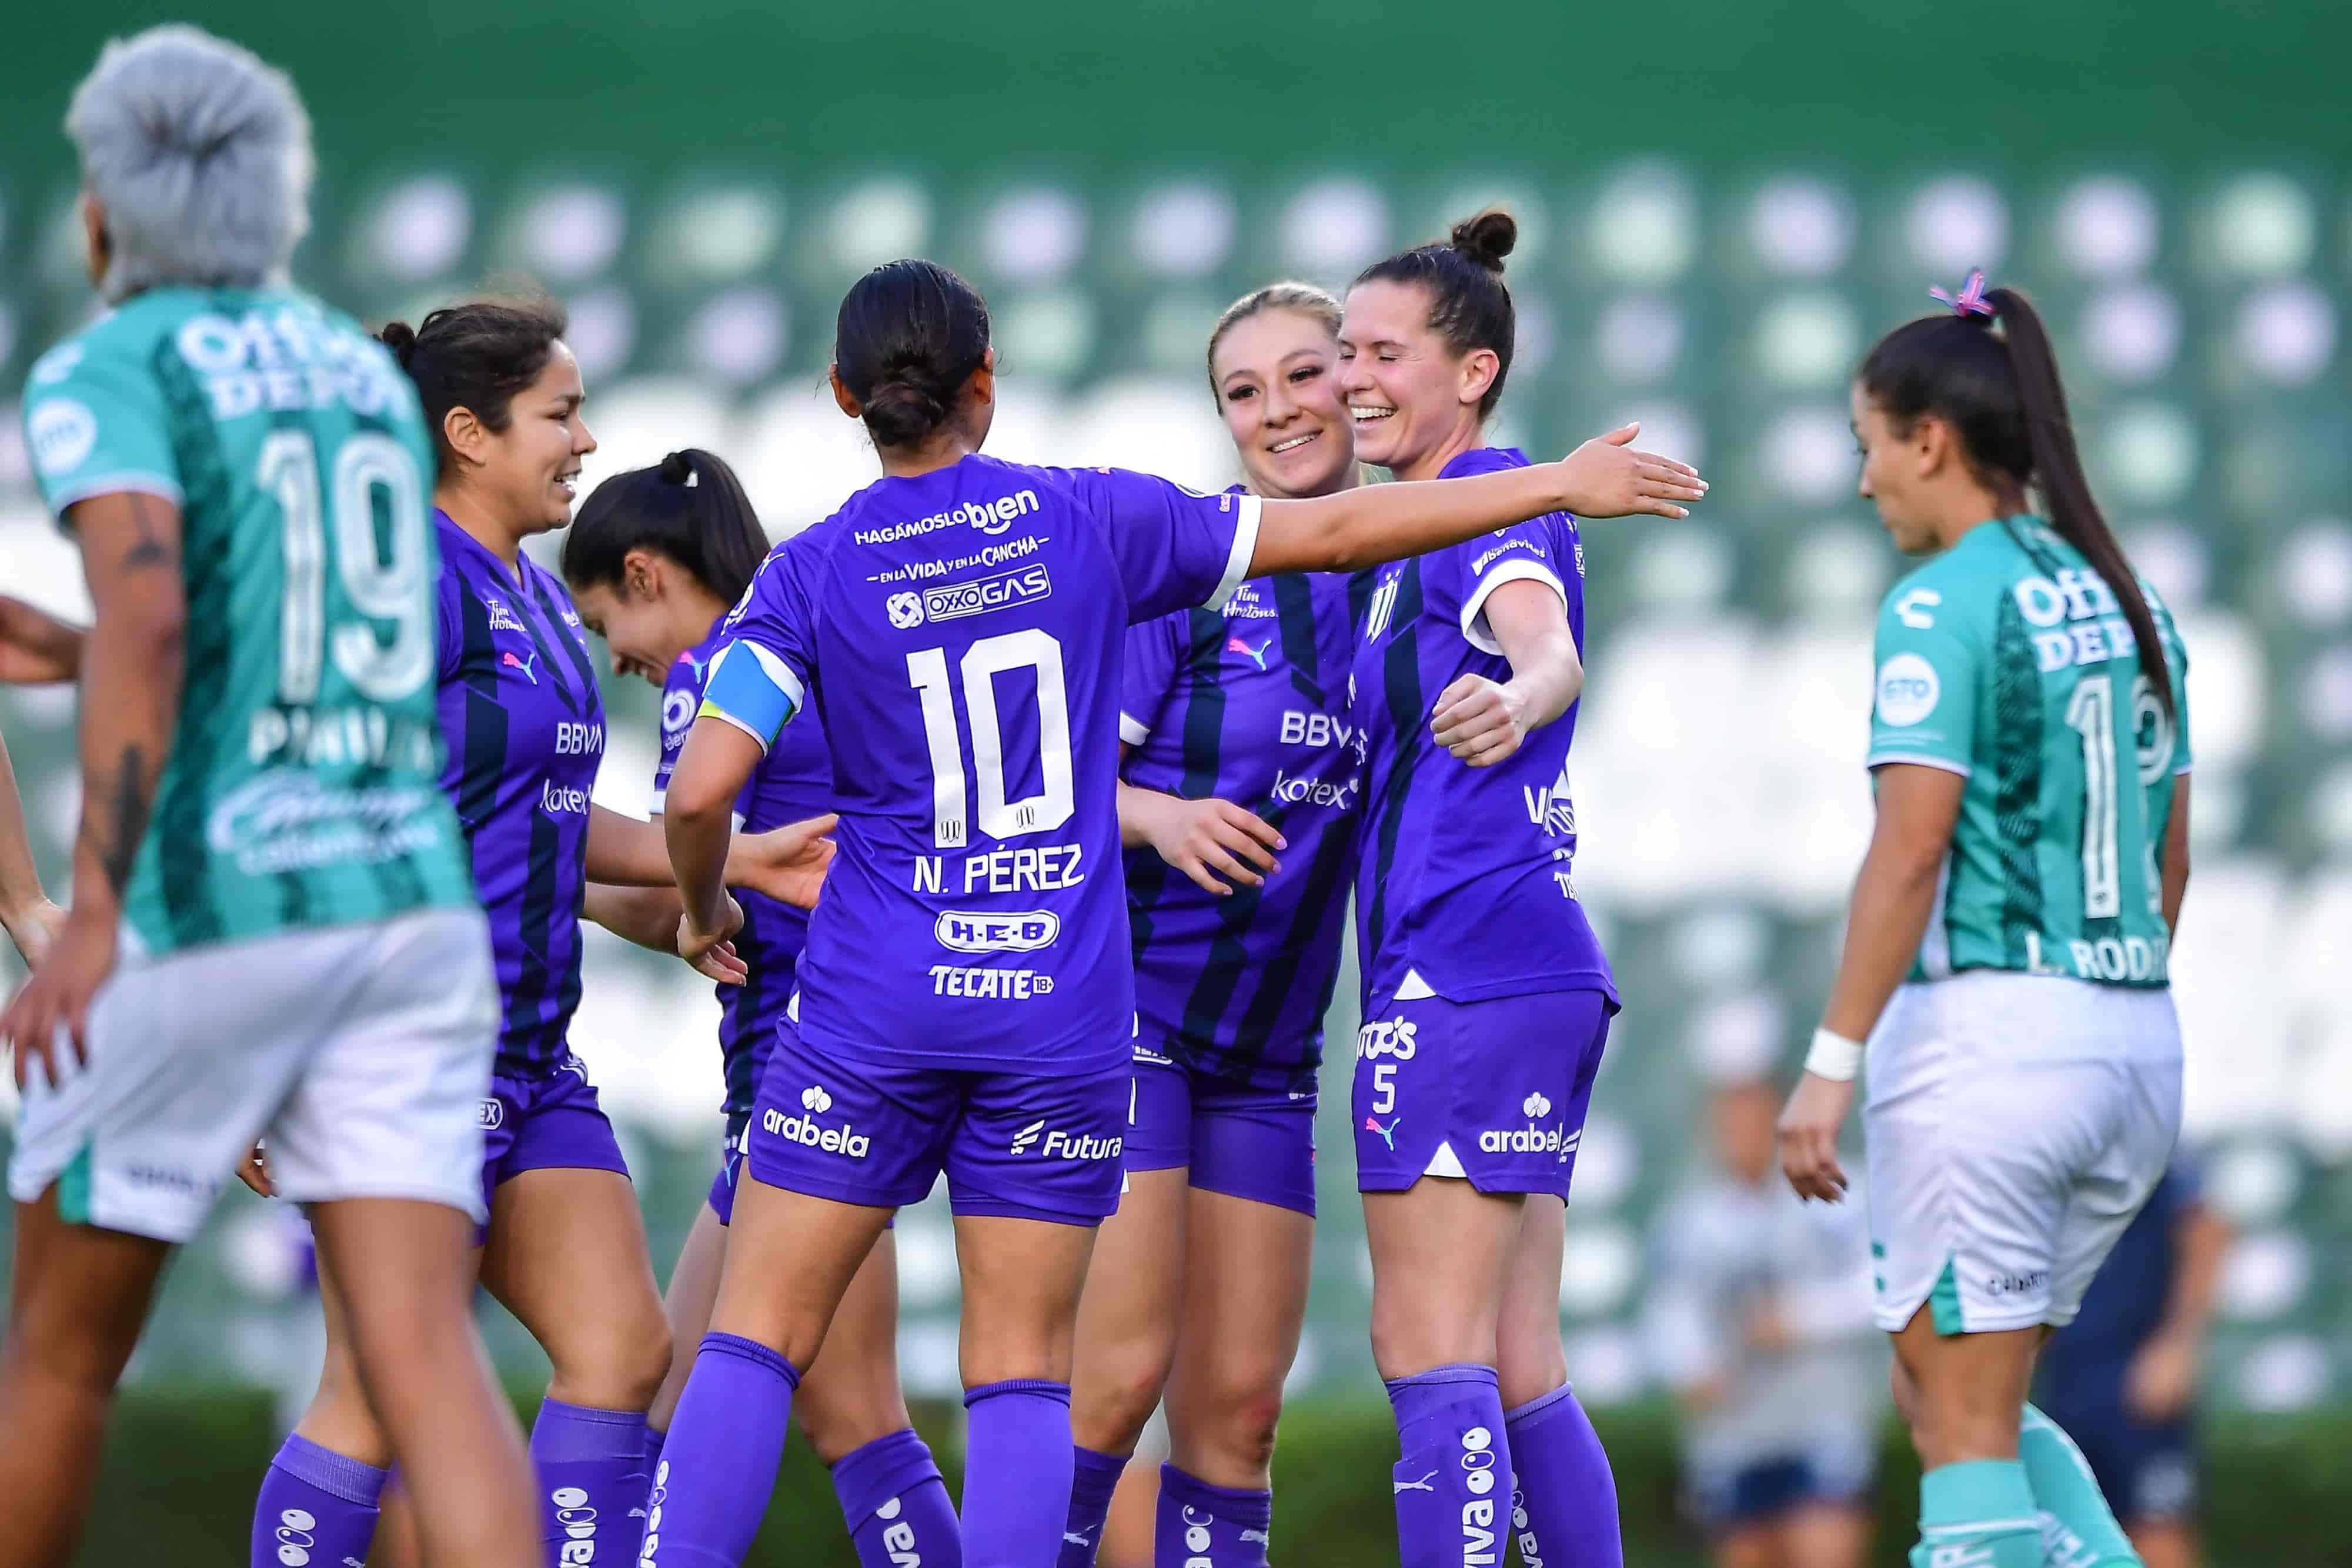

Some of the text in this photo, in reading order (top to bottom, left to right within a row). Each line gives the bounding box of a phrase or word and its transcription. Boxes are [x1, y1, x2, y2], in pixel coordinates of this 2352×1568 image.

[854, 489, 1040, 546] HAGÁMOSLO bien
[258, 429, 435, 704] 19
[880, 536, 1038, 583] EN LA VIDA Y EN LA CANCHA
[487, 600, 509, 617] Tim
[929, 570, 1048, 613] OXXO GAS
[1237, 584, 1259, 603] Tim
[555, 721, 603, 755] BBVA
[906, 628, 1075, 848] 10
[1280, 710, 1352, 749] BBV
[539, 778, 587, 816] kotex
[1270, 770, 1348, 810] kotex
[912, 843, 1085, 894] N. PÉREZ
[928, 965, 1053, 1000] TECATE 18+
[1372, 1065, 1397, 1114] 5
[763, 1108, 870, 1158] arabela
[1042, 1131, 1122, 1160] Futura
[1479, 1122, 1562, 1153] arabel
